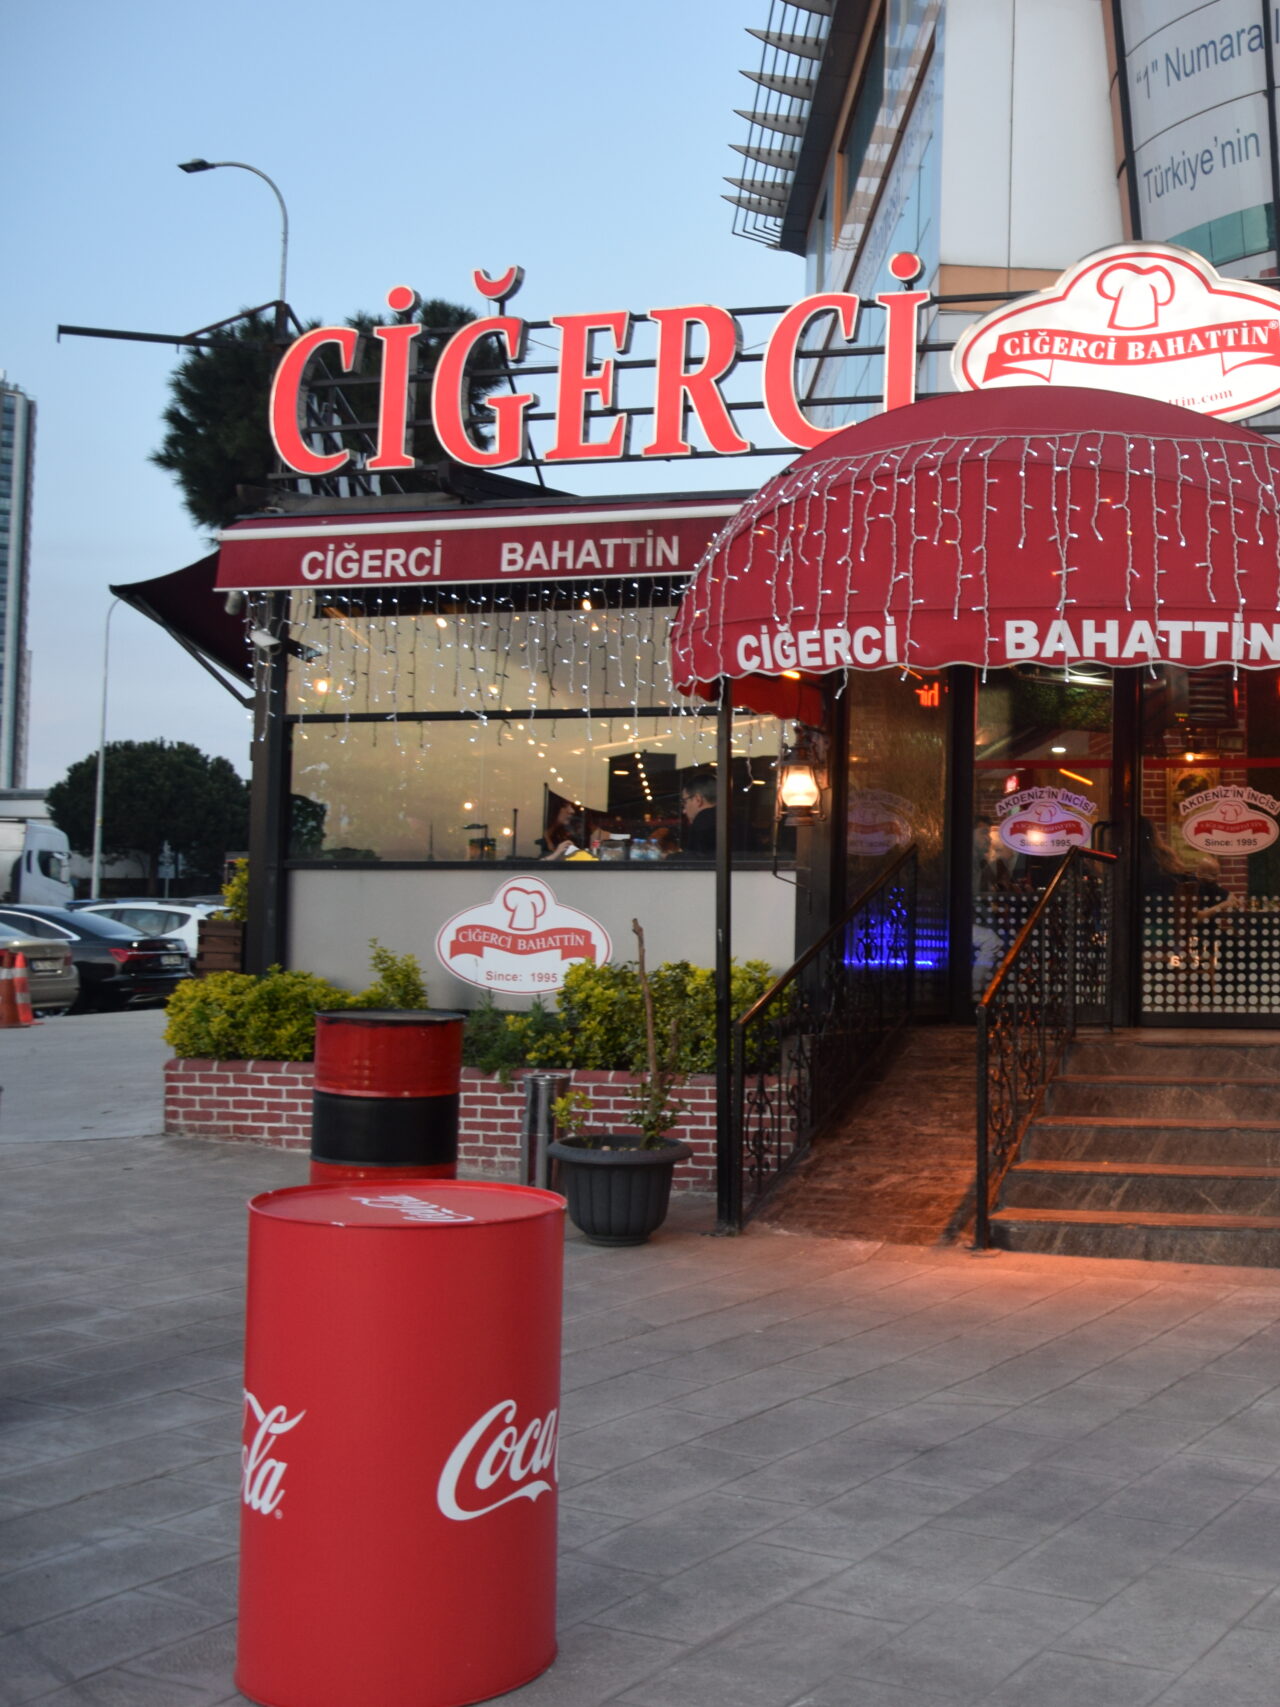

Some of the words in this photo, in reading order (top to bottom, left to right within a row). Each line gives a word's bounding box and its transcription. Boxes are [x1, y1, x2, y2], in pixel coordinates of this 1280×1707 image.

[1003, 331, 1118, 361] CİĞERCİ
[1127, 321, 1270, 361] BAHATTİN
[269, 251, 931, 476] CİĞERCİ
[300, 539, 443, 581] CİĞERCİ
[499, 529, 680, 573] BAHATTİN
[736, 619, 898, 671] CİĞERCİ
[1236, 838, 1258, 846] 1995
[458, 928, 512, 949] CİĞERCİ
[517, 931, 586, 951] BAHATTİN
[485, 970, 524, 983] Since:
[530, 972, 559, 983] 1995
